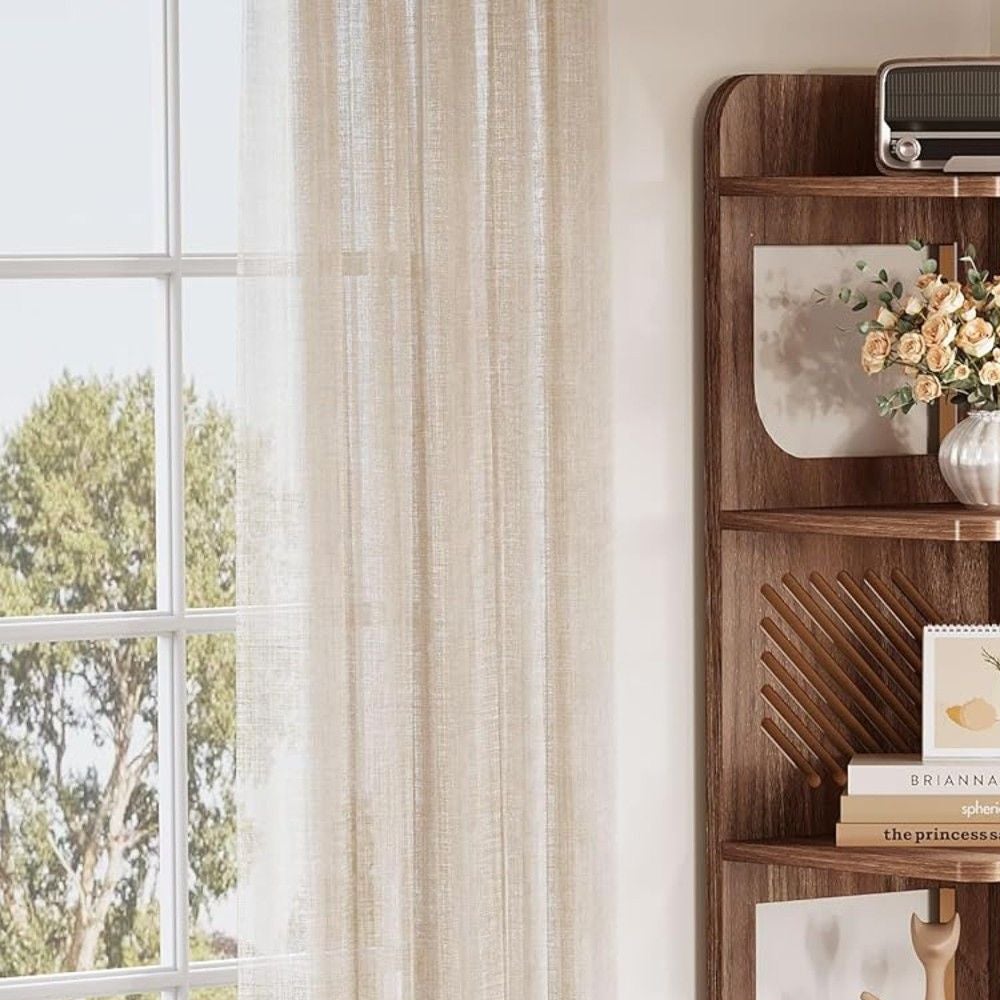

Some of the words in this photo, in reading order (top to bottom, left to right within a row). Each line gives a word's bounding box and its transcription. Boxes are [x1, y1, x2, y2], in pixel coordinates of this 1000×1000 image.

[911, 774, 998, 786] BRIANNA
[883, 828, 912, 841] the
[914, 828, 988, 844] princess
